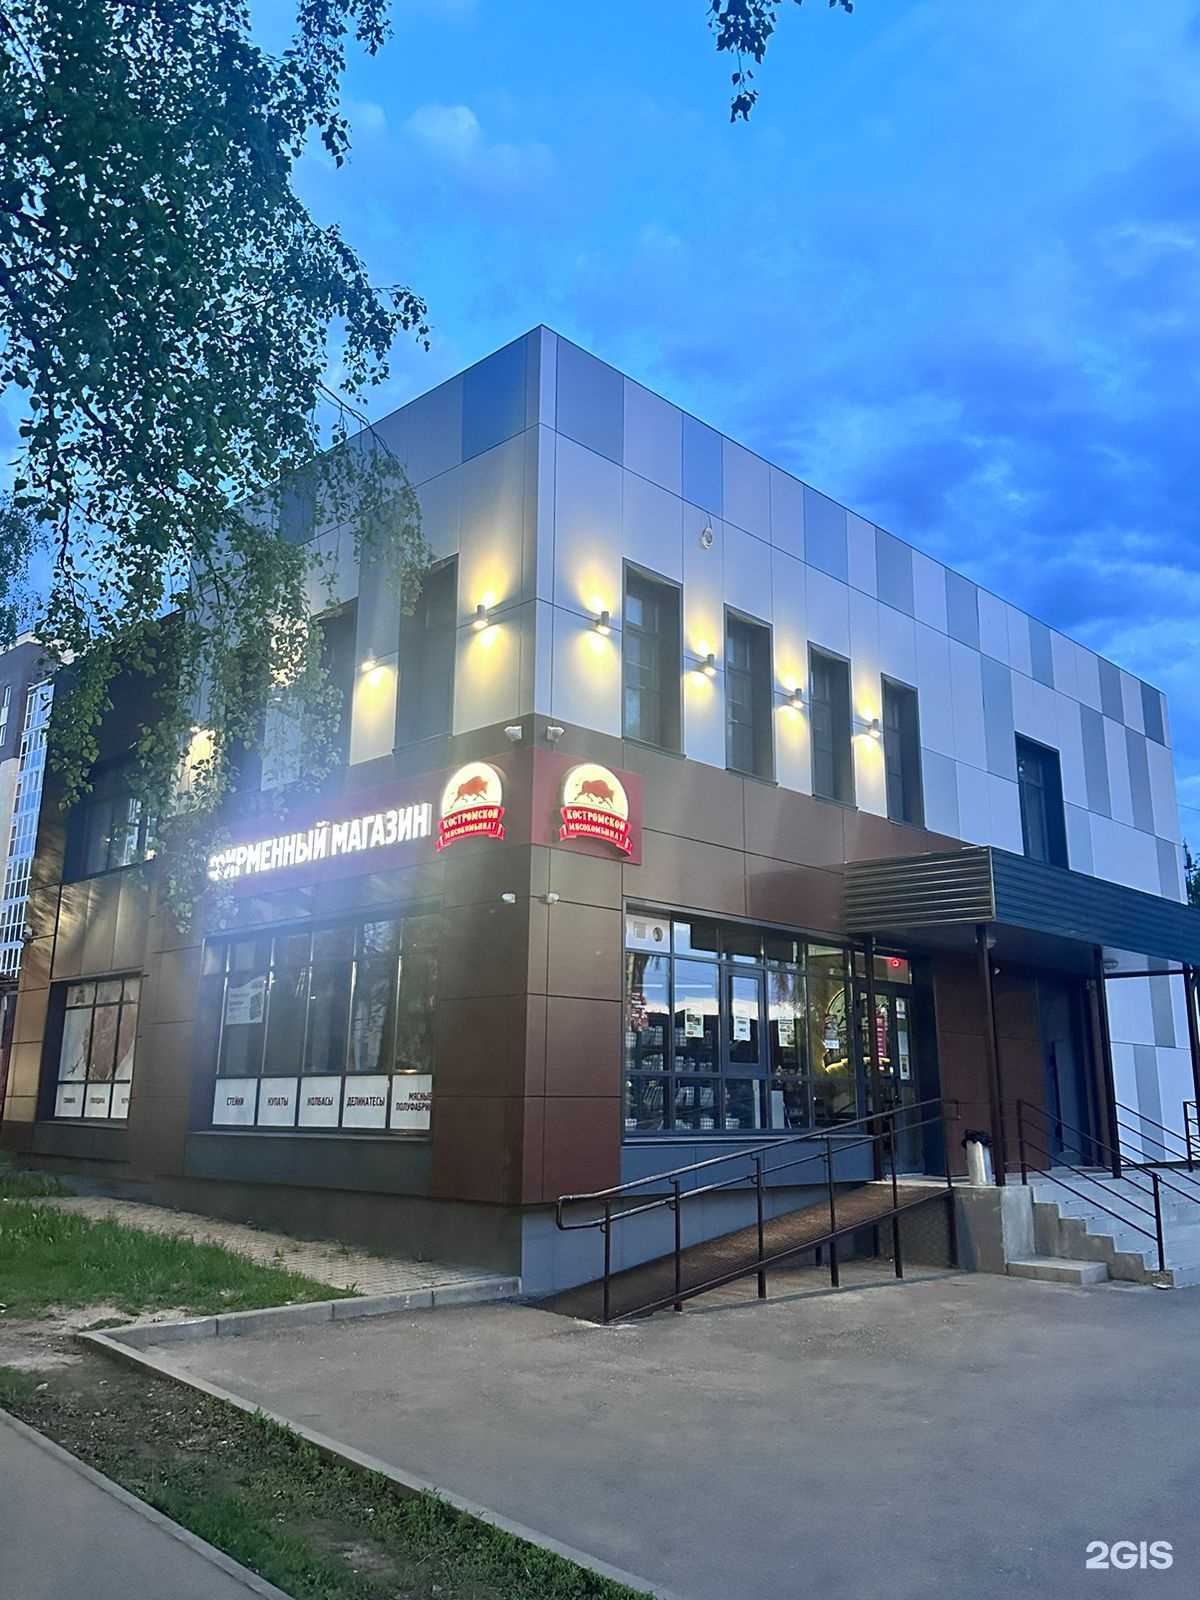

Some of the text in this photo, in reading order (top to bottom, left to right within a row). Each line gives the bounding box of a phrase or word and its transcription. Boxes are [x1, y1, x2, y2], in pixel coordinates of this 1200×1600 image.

[443, 809, 499, 828] КОСТРОМСКОЙ
[567, 809, 626, 831] КОСТРОМСКОЙ
[332, 802, 433, 856] МАГАЗИН
[306, 1096, 334, 1106] КОЛБАСЫ
[346, 1096, 386, 1108] ДЕЛИКАТЕСЫ
